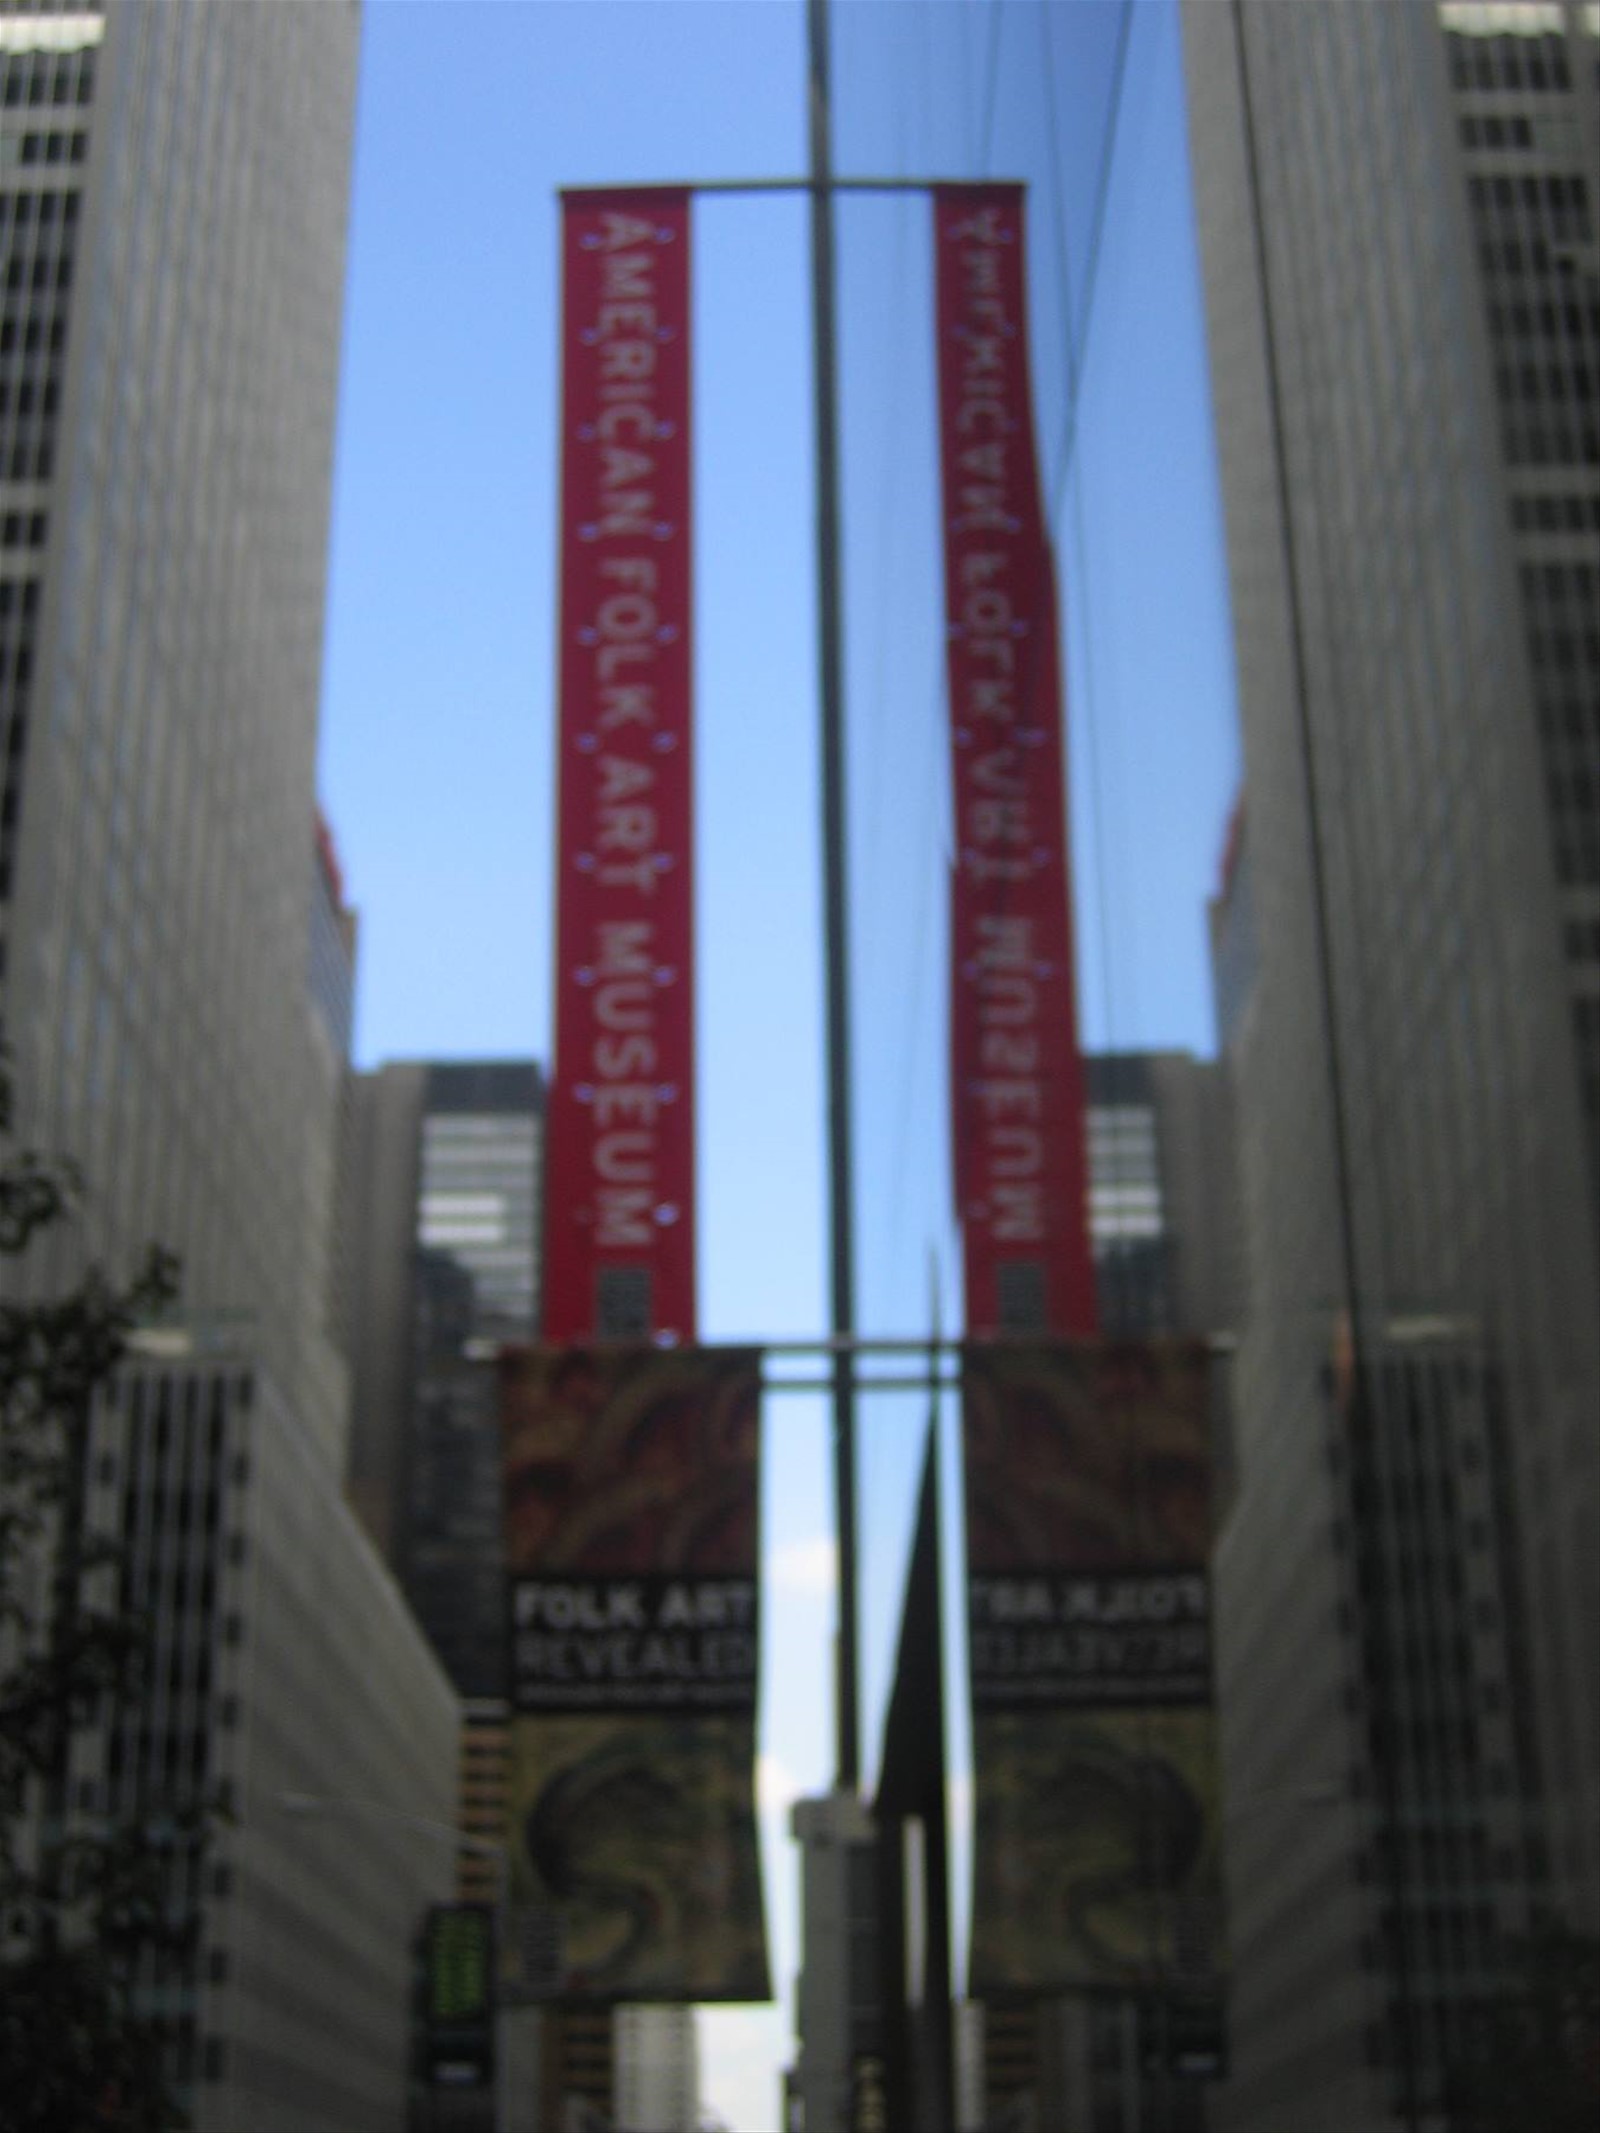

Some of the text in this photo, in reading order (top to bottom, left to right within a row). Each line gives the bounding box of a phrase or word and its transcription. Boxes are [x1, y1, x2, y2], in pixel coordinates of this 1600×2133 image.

[594, 211, 656, 1246] AMERICAN FOLK ART MUSEUM
[515, 1582, 752, 1629] FOLK ART
